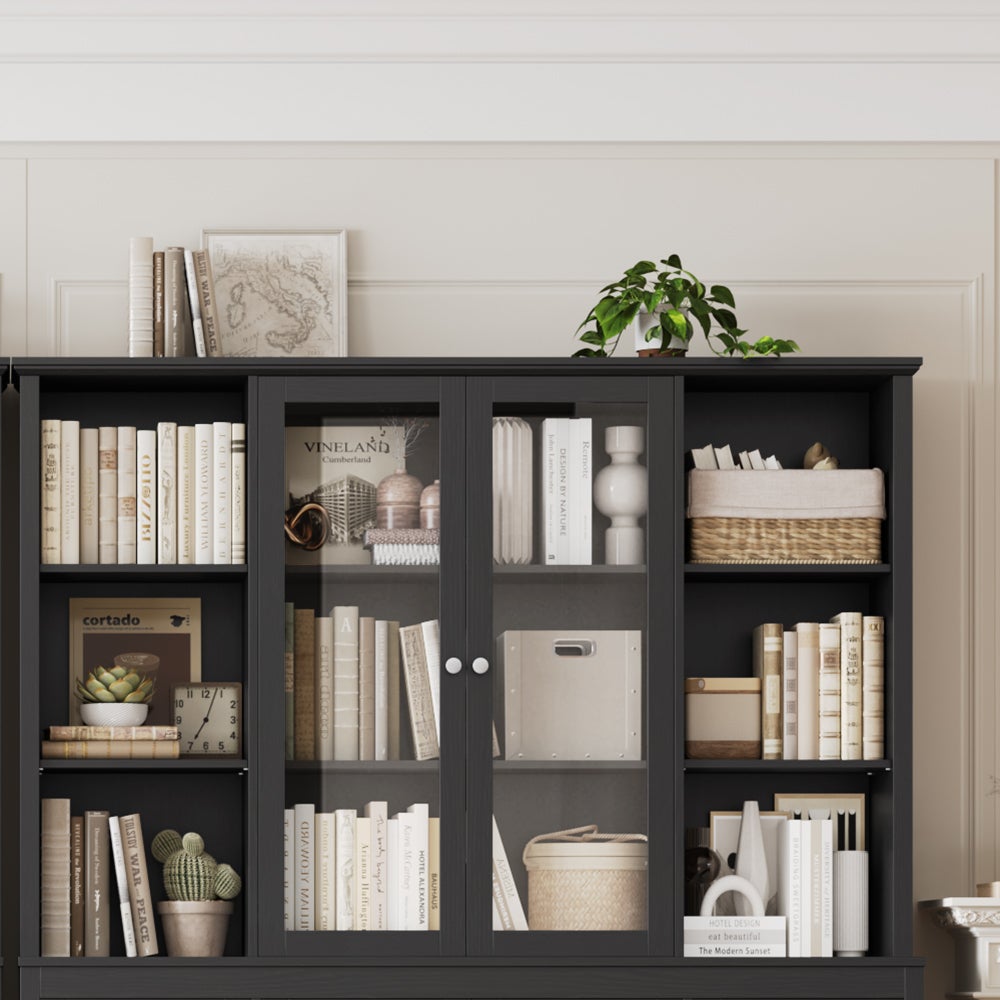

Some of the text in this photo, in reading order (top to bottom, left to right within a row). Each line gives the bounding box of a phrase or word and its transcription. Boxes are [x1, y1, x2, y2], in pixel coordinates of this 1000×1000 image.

[201, 280, 210, 306] WAR
[206, 316, 218, 352] PEACE
[304, 441, 390, 453] VINELAND
[322, 456, 372, 464] Cumberland
[582, 441, 590, 479] Remote
[560, 486, 566, 496] BY
[200, 502, 209, 551] WILLIAM
[82, 614, 140, 626] cortado
[340, 618, 352, 632] A
[187, 690, 193, 698] 11
[202, 690, 210, 698] 12
[175, 700, 236, 708] 10 2
[176, 716, 236, 724] 9 3
[230, 732, 236, 740] 4
[188, 742, 224, 750] 7 6 5
[124, 817, 150, 943] TOLSTOY WAR PEACE
[708, 920, 761, 928] HOTEL DESIGN
[708, 932, 761, 941] eat beautiful
[699, 947, 771, 955] The Modern Sunset
